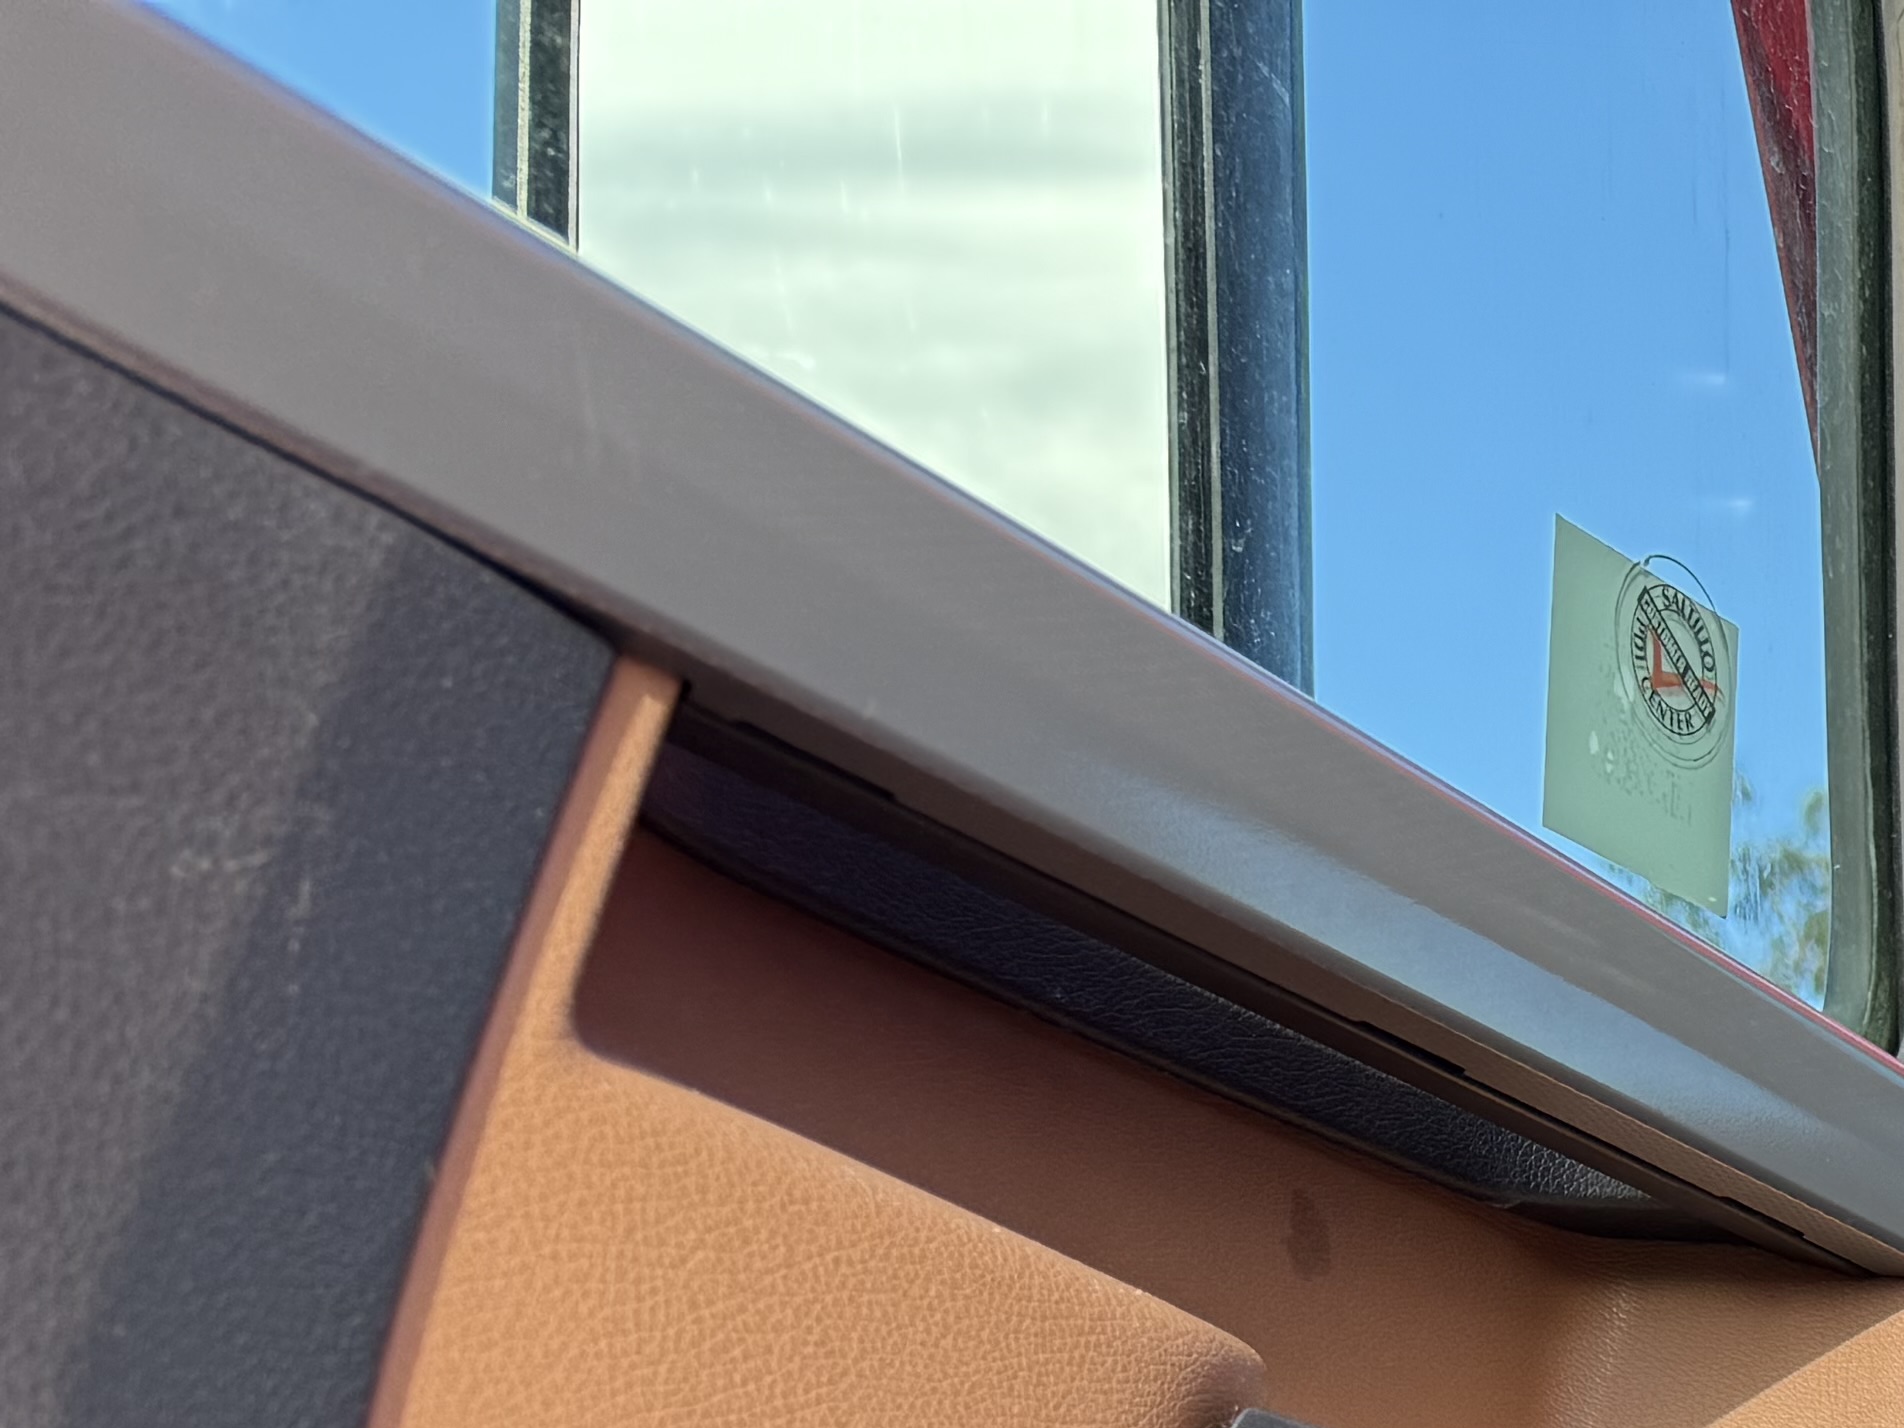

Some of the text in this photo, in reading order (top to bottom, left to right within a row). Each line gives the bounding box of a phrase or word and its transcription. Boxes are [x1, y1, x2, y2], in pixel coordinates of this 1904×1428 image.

[1661, 586, 1714, 672] SALTILLO
[1641, 677, 1695, 732] CENTER
[1684, 673, 1712, 716] READY
